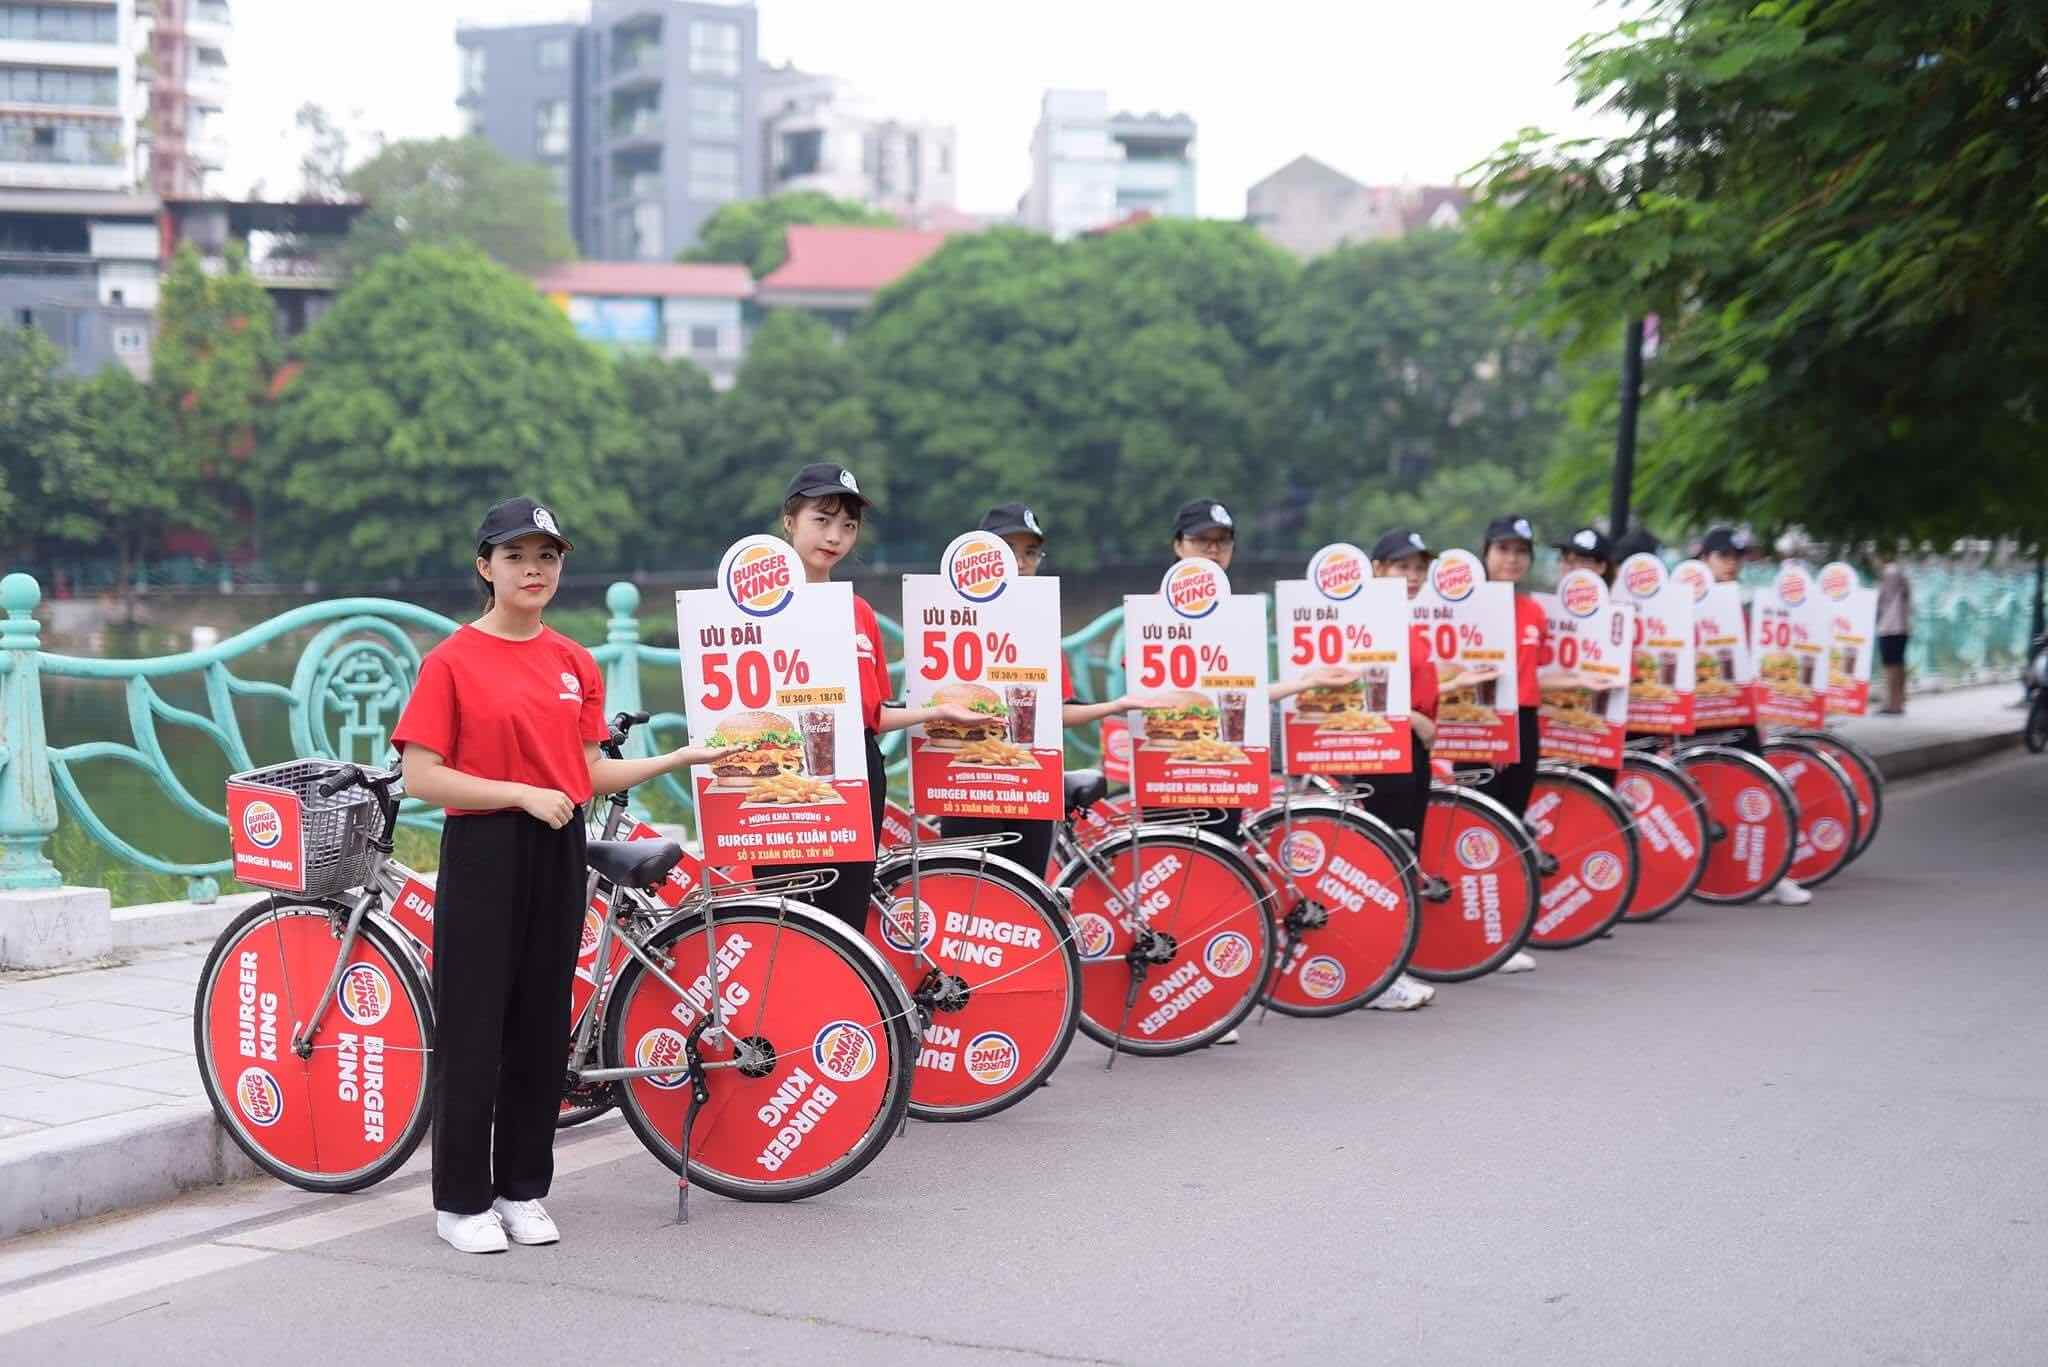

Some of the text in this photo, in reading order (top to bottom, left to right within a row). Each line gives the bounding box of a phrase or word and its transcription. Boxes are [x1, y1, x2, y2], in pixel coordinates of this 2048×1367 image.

[733, 554, 786, 585] BURGER
[955, 550, 1002, 574] BURGER
[957, 561, 1004, 589] KING
[1321, 569, 1361, 589] KING
[736, 567, 790, 604] KING
[1171, 571, 1214, 594] BURGER
[1173, 582, 1216, 606] KING
[700, 623, 762, 647] ƯU ĐÃI
[923, 606, 977, 626] ƯU ĐÃI
[920, 631, 1017, 681] 50%
[1291, 625, 1372, 666] 50%
[700, 649, 810, 711] 50%
[1140, 644, 1228, 689] 50%
[792, 693, 812, 703] 30/9
[927, 788, 967, 800] BURGER
[970, 789, 994, 801] KING
[249, 820, 277, 834] KING
[717, 833, 763, 848] BURGER
[766, 832, 793, 846] KING
[796, 829, 828, 845] XUÂN
[236, 852, 293, 871] BURGER KING
[1316, 874, 1365, 912] KING
[1328, 855, 1399, 911] BURGER
[944, 911, 1041, 949] BURGER
[940, 937, 1003, 968] KING
[350, 971, 373, 1019] KING
[363, 970, 380, 1018] BURGER
[1149, 960, 1200, 1003] KING
[240, 951, 258, 1058] BURGER
[1138, 976, 1215, 1035] BURGER
[259, 991, 278, 1061] KING
[338, 1032, 359, 1102] KING
[827, 1024, 856, 1074] KING
[840, 1033, 865, 1078] BURGER
[971, 1046, 1011, 1062] KING
[971, 1060, 1010, 1072] BURGER
[244, 1074, 261, 1120] BURGER
[252, 1073, 272, 1118] KING
[363, 1034, 384, 1143] BURGER
[757, 1067, 814, 1127] KING
[756, 1083, 839, 1172] BURGER
